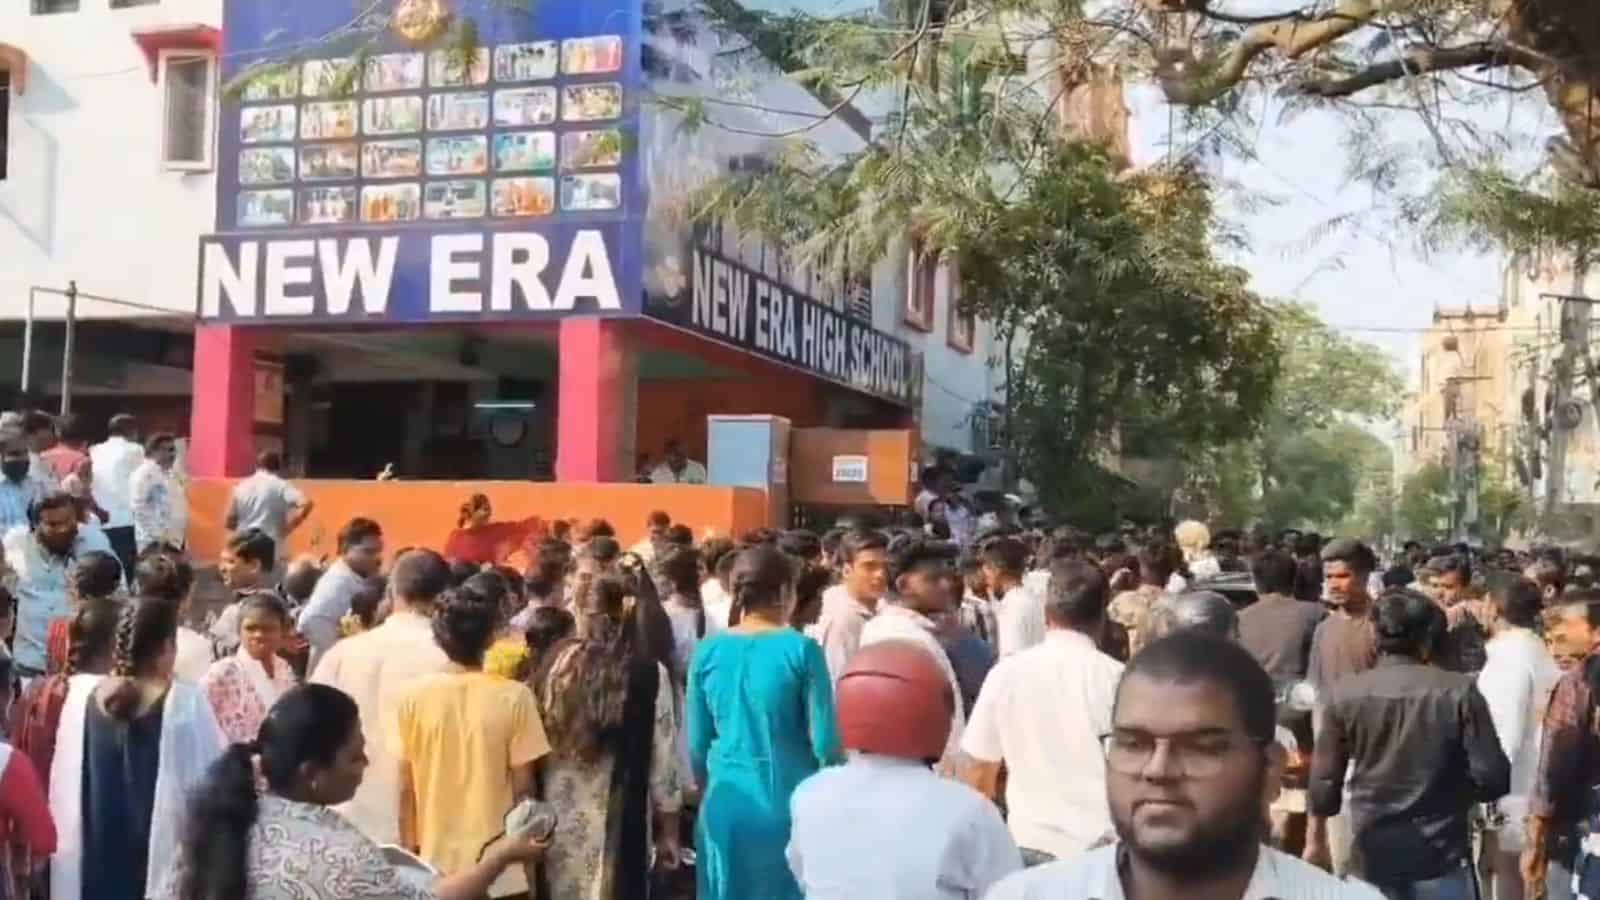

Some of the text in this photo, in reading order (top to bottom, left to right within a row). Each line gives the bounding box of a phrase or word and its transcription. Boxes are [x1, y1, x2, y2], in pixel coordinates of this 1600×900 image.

[202, 230, 621, 317] NEW ERA
[692, 250, 749, 341] NEW
[754, 279, 797, 361] ERA
[802, 303, 848, 377] HIGH
[850, 325, 908, 398] SCHOOL
